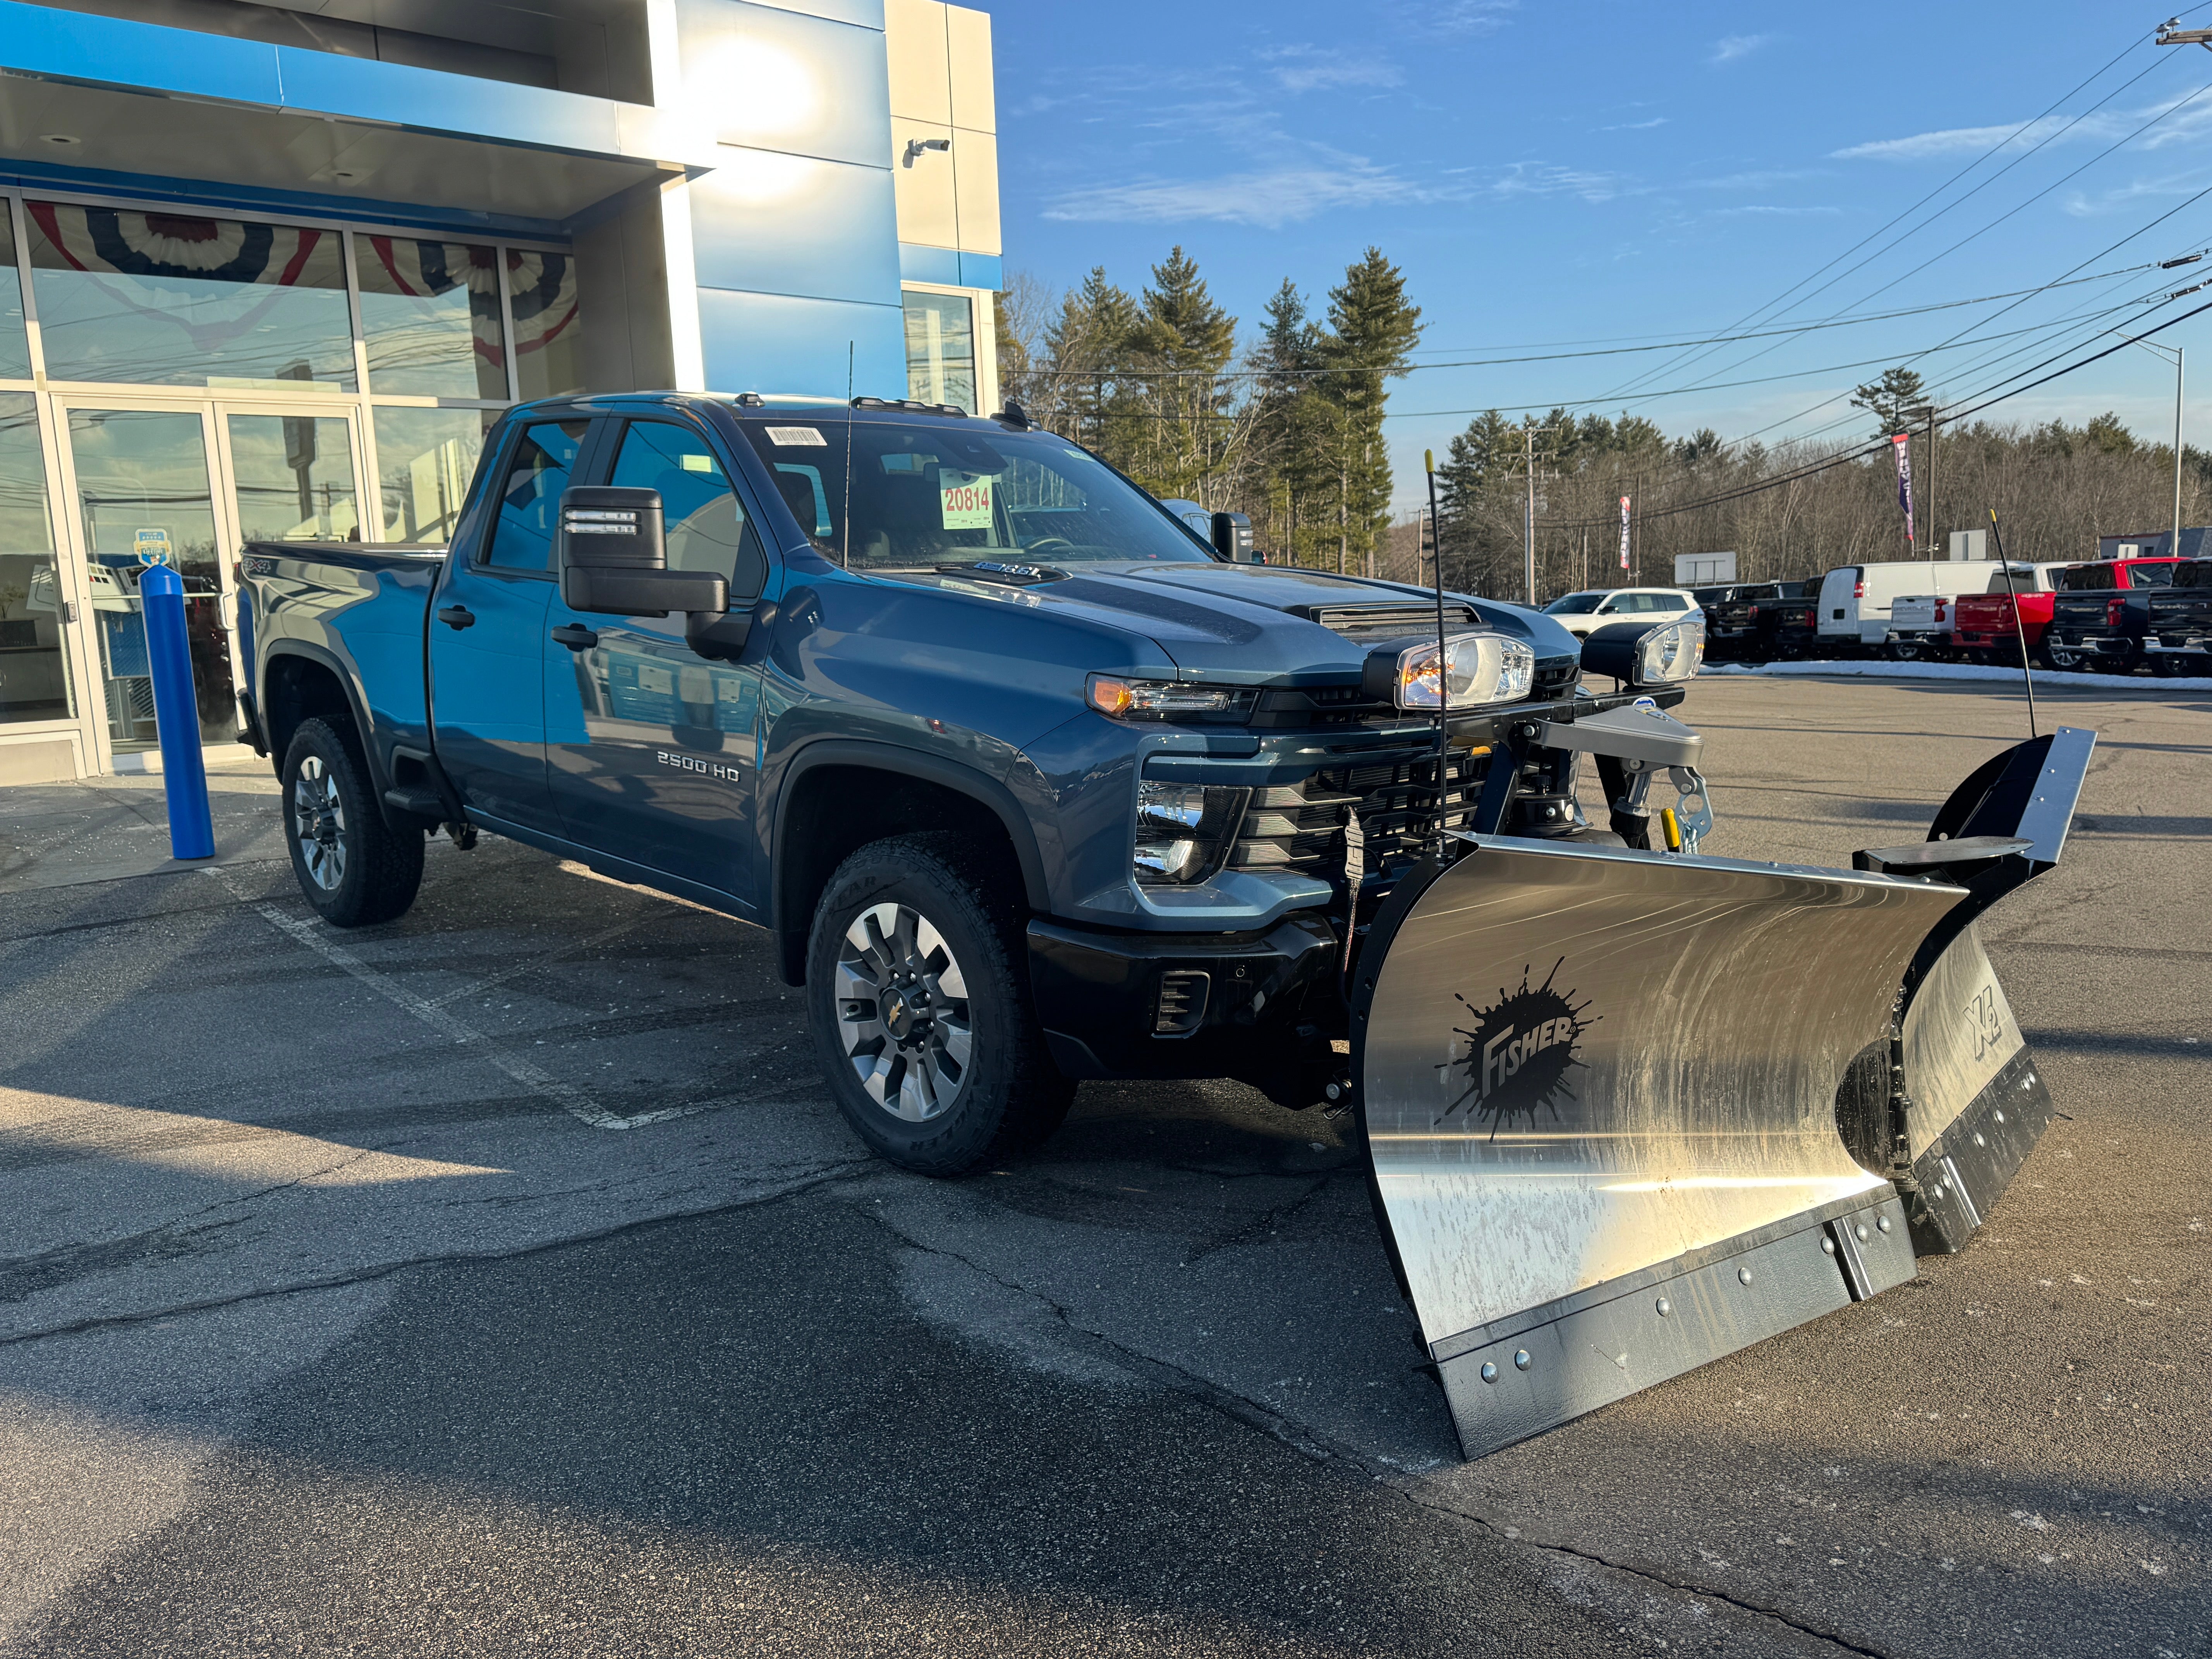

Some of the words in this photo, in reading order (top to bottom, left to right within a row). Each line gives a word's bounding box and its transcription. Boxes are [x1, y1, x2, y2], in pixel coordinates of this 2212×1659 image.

[946, 487, 989, 511] 20814
[658, 751, 708, 774] 2500
[714, 764, 740, 782] HD
[1482, 1017, 1572, 1100] FISHER
